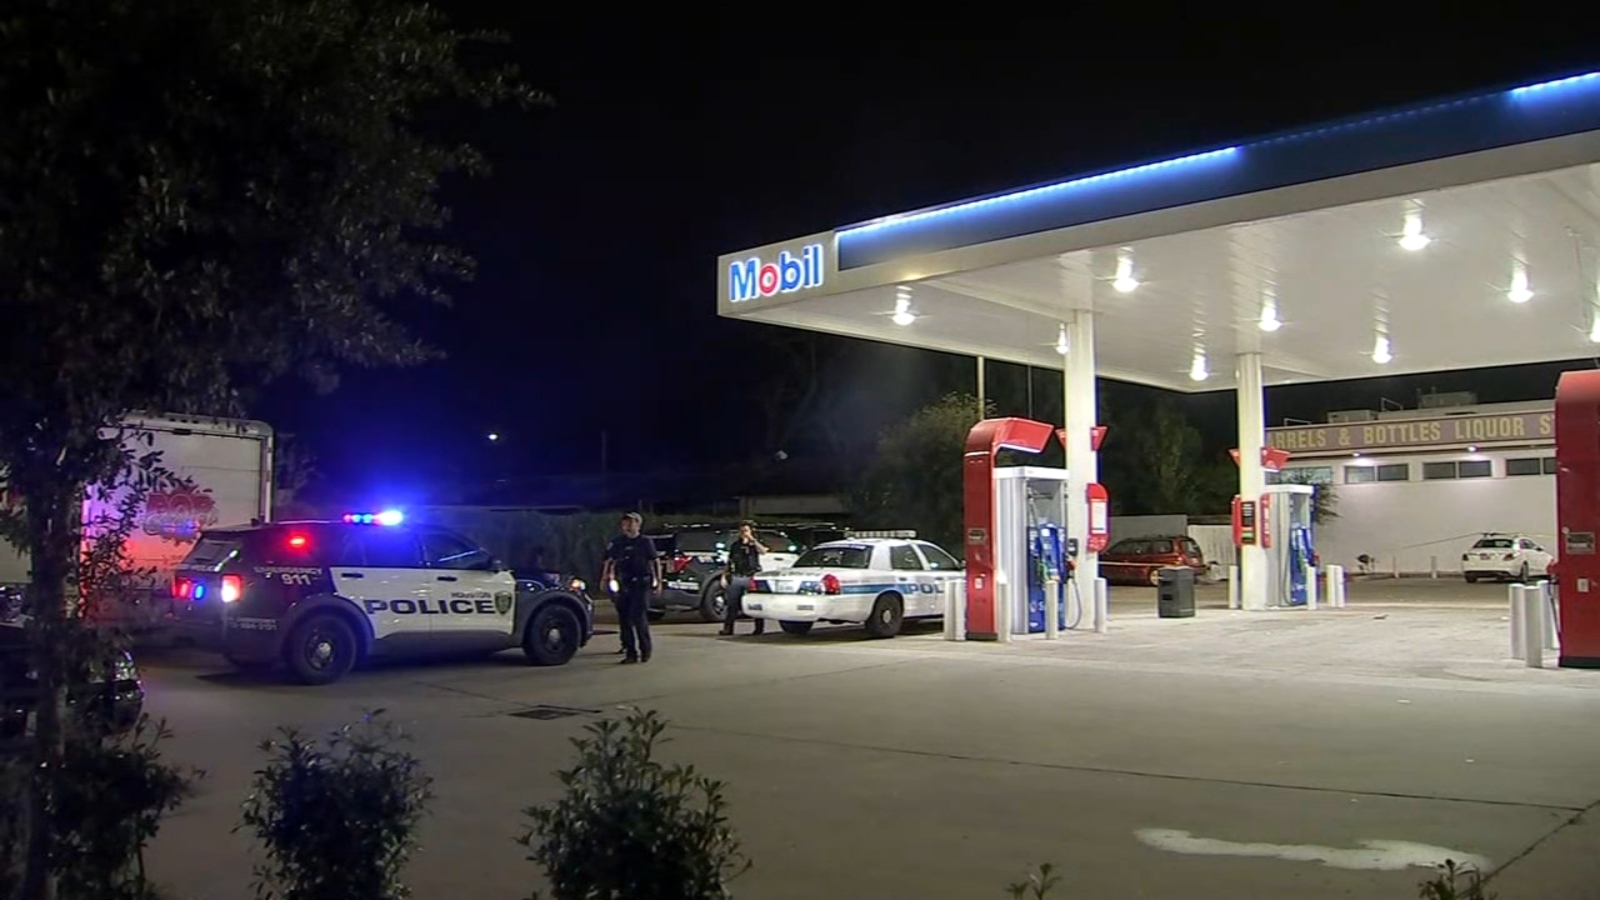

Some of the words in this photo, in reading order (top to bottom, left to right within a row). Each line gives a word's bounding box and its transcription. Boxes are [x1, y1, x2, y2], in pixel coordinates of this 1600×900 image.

[729, 243, 824, 302] Mobil
[1339, 427, 1350, 446] &
[1364, 422, 1440, 444] BOTTLES
[1455, 417, 1524, 439] LIQUOR
[1539, 414, 1554, 435] S
[281, 573, 311, 585] 911
[363, 600, 496, 614] POLICE
